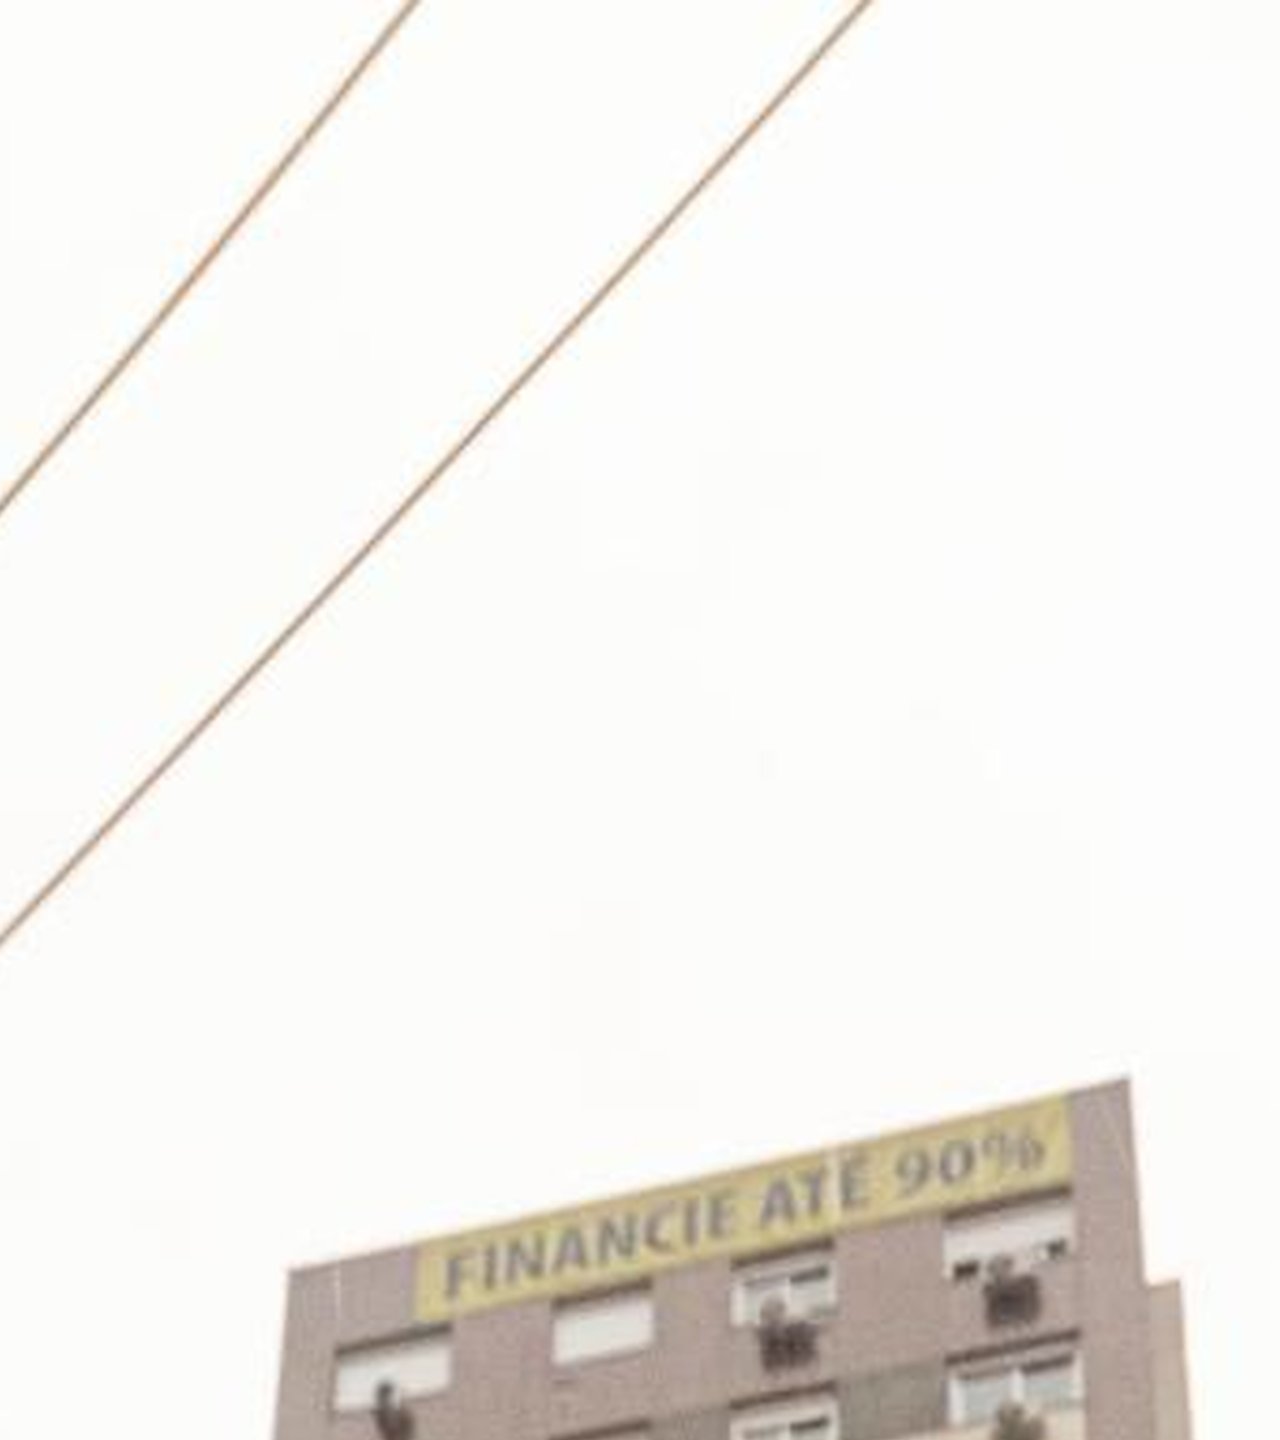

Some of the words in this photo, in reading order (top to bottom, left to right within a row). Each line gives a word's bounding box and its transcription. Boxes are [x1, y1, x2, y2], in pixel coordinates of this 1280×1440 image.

[444, 1187, 735, 1300] FINANCIE
[759, 1149, 870, 1232] ATÉ
[895, 1126, 1047, 1191] 90%
